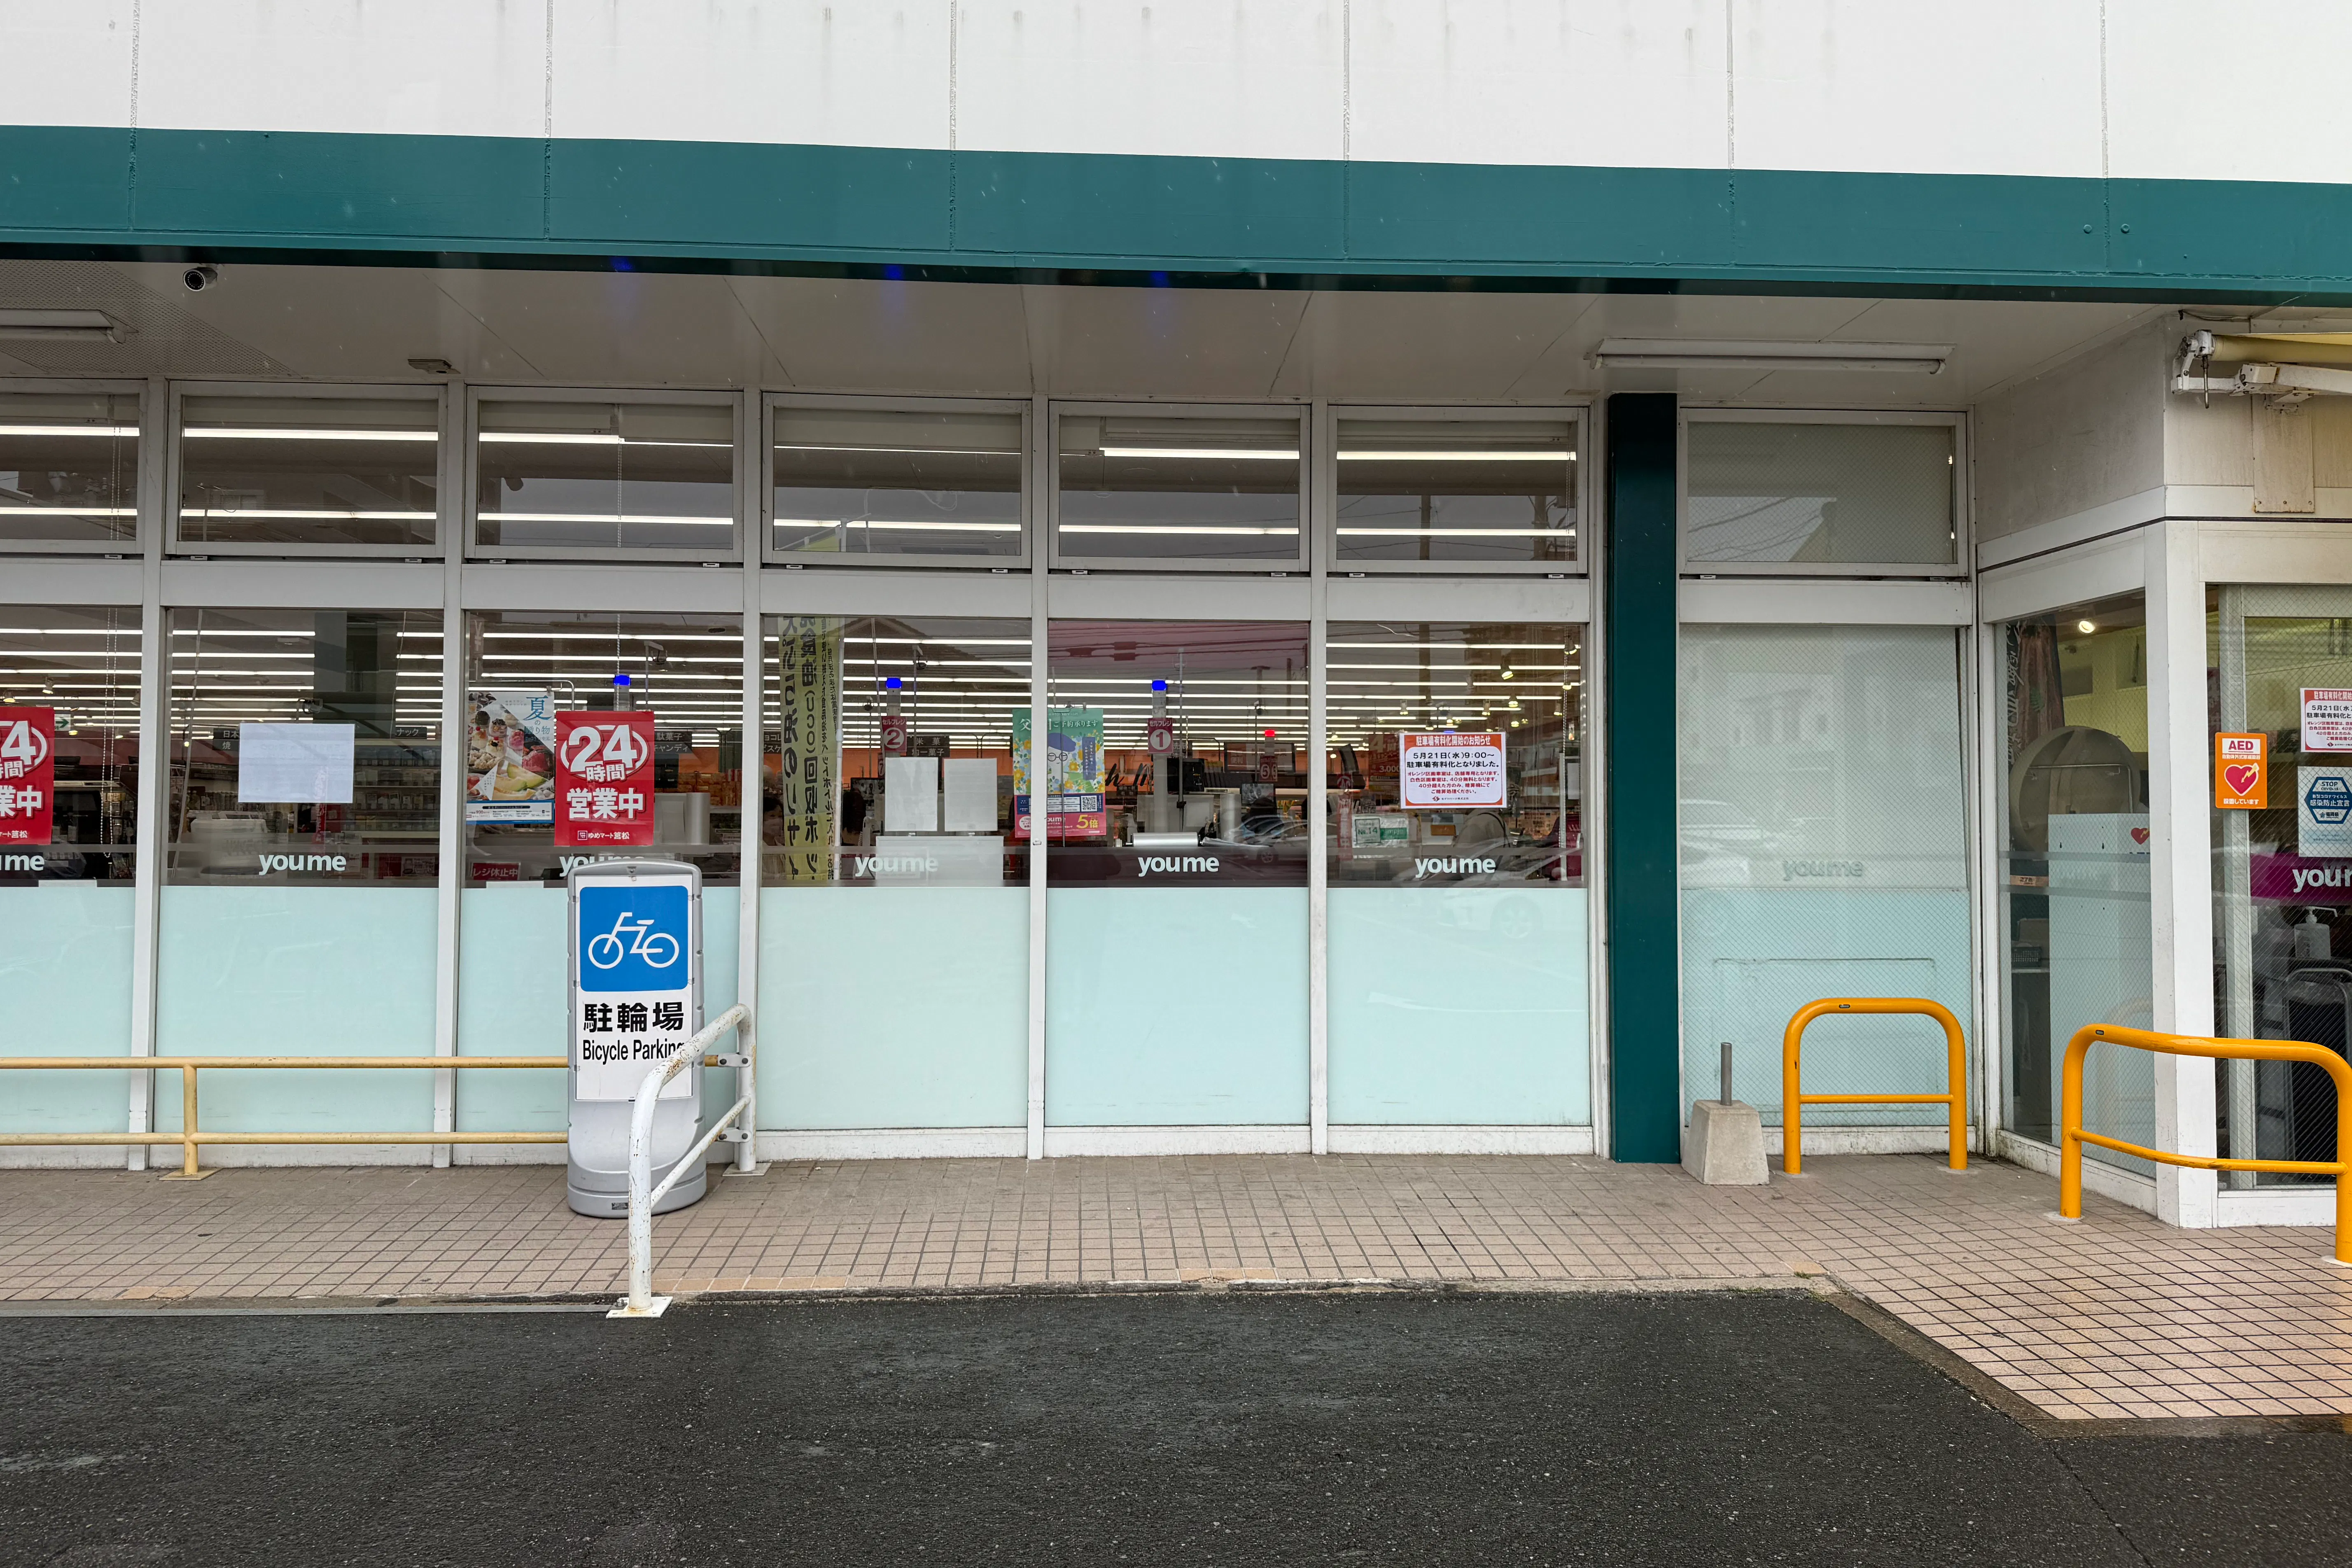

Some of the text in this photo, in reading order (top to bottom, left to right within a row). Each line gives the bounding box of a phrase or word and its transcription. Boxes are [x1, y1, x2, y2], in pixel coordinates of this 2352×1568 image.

[523, 695, 552, 721] 夏
[887, 729, 901, 745] 2
[1156, 732, 1164, 747] 1
[1416, 735, 1491, 746] 駐車場有料化開始のお知らせ
[2228, 740, 2254, 750] AED
[569, 724, 637, 772] 24
[0, 759, 24, 779] 間
[586, 763, 625, 782] 時間
[567, 787, 644, 819] 営業中
[473, 868, 518, 877] レジ休止中
[583, 1001, 684, 1033] 駐輪場
[583, 1039, 628, 1065] Bicycle
